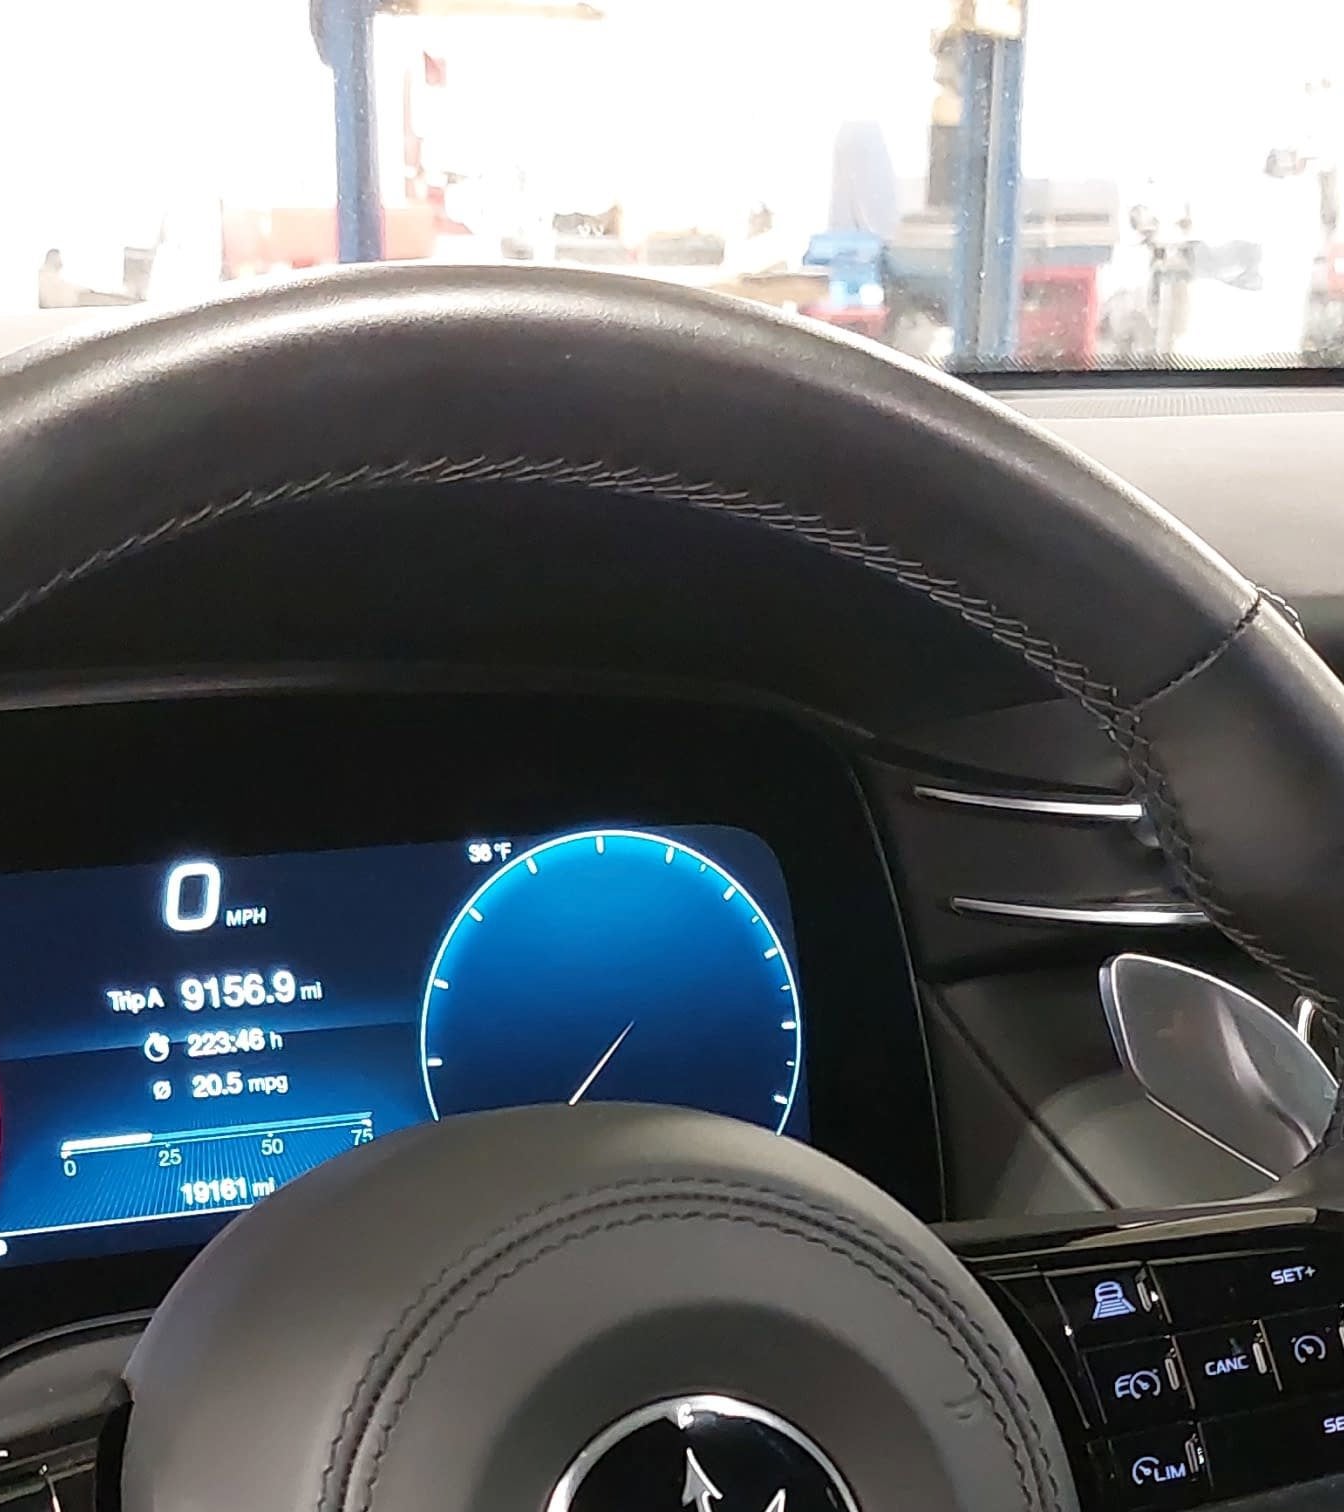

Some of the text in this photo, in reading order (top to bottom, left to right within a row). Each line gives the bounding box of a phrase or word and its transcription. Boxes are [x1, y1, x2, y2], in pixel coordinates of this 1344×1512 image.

[165, 862, 267, 931] 0 MPH
[106, 970, 324, 1014] Trip A 9156.9 mi
[187, 1028, 283, 1058] 223:46 h
[192, 1071, 289, 1098] 20.5 mpg
[62, 1126, 374, 1178] 0 25 50 75
[180, 1175, 275, 1206] 19161 mi
[1270, 1265, 1318, 1286] SET+
[1205, 1353, 1250, 1377] CANC
[1153, 1462, 1187, 1482] LIM
